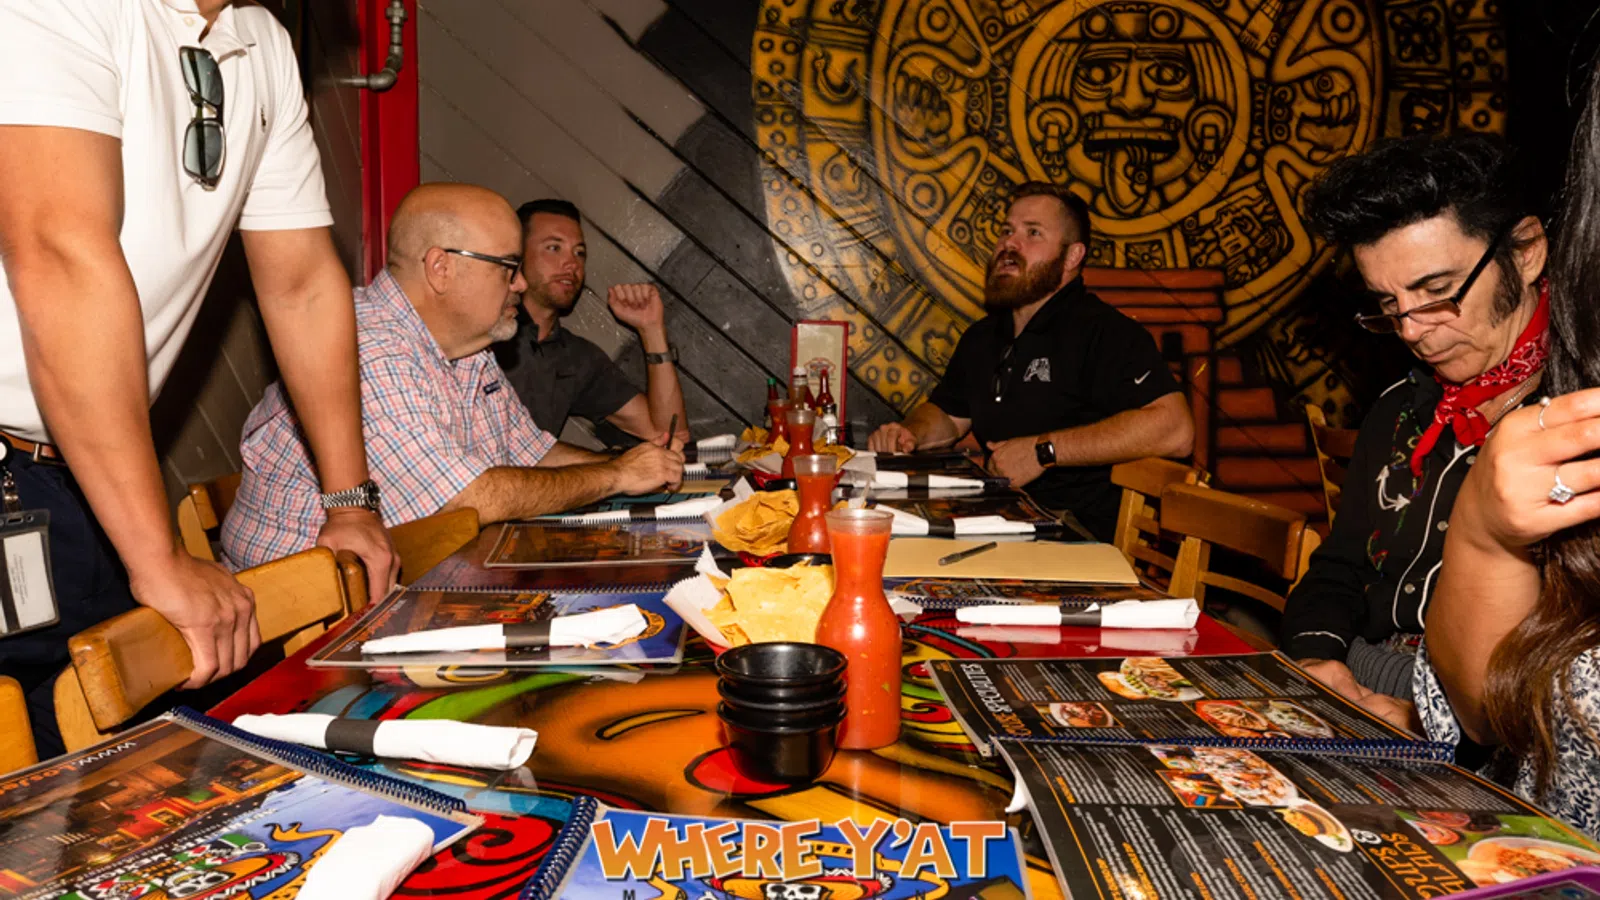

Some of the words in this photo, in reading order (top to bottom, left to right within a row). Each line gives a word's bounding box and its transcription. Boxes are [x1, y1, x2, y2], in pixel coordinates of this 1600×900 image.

[74, 851, 167, 889] MEXICAN
[1369, 846, 1446, 900] OUPS
[1380, 832, 1466, 895] ALADS
